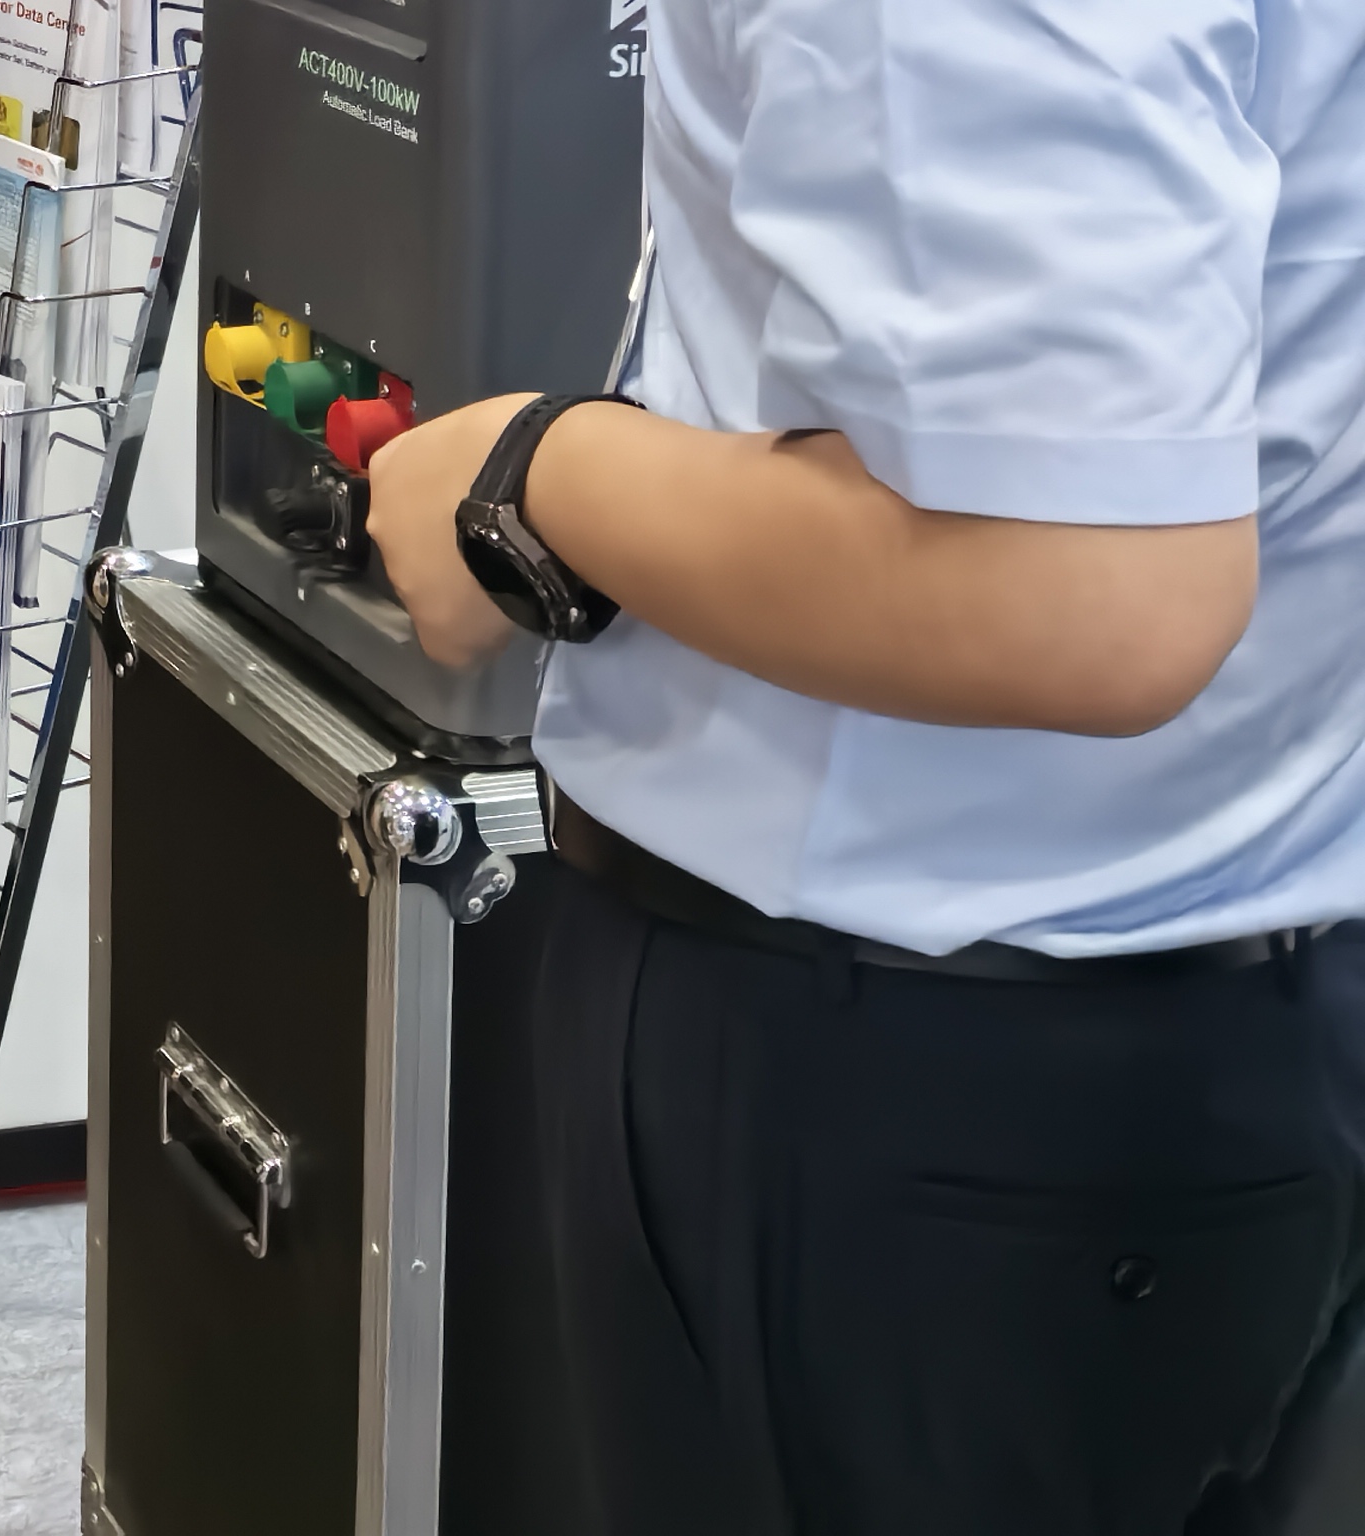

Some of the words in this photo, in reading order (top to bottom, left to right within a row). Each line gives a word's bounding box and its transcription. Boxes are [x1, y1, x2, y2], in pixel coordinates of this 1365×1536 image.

[17, 1, 44, 25] Data
[47, 11, 86, 37] Cenre
[609, 43, 647, 79] Si
[298, 46, 421, 116] ACT400V-100kW
[322, 90, 368, 122] Automatic
[369, 108, 393, 132] Load
[244, 269, 251, 283] A
[304, 302, 311, 316] B
[370, 339, 377, 353] C
